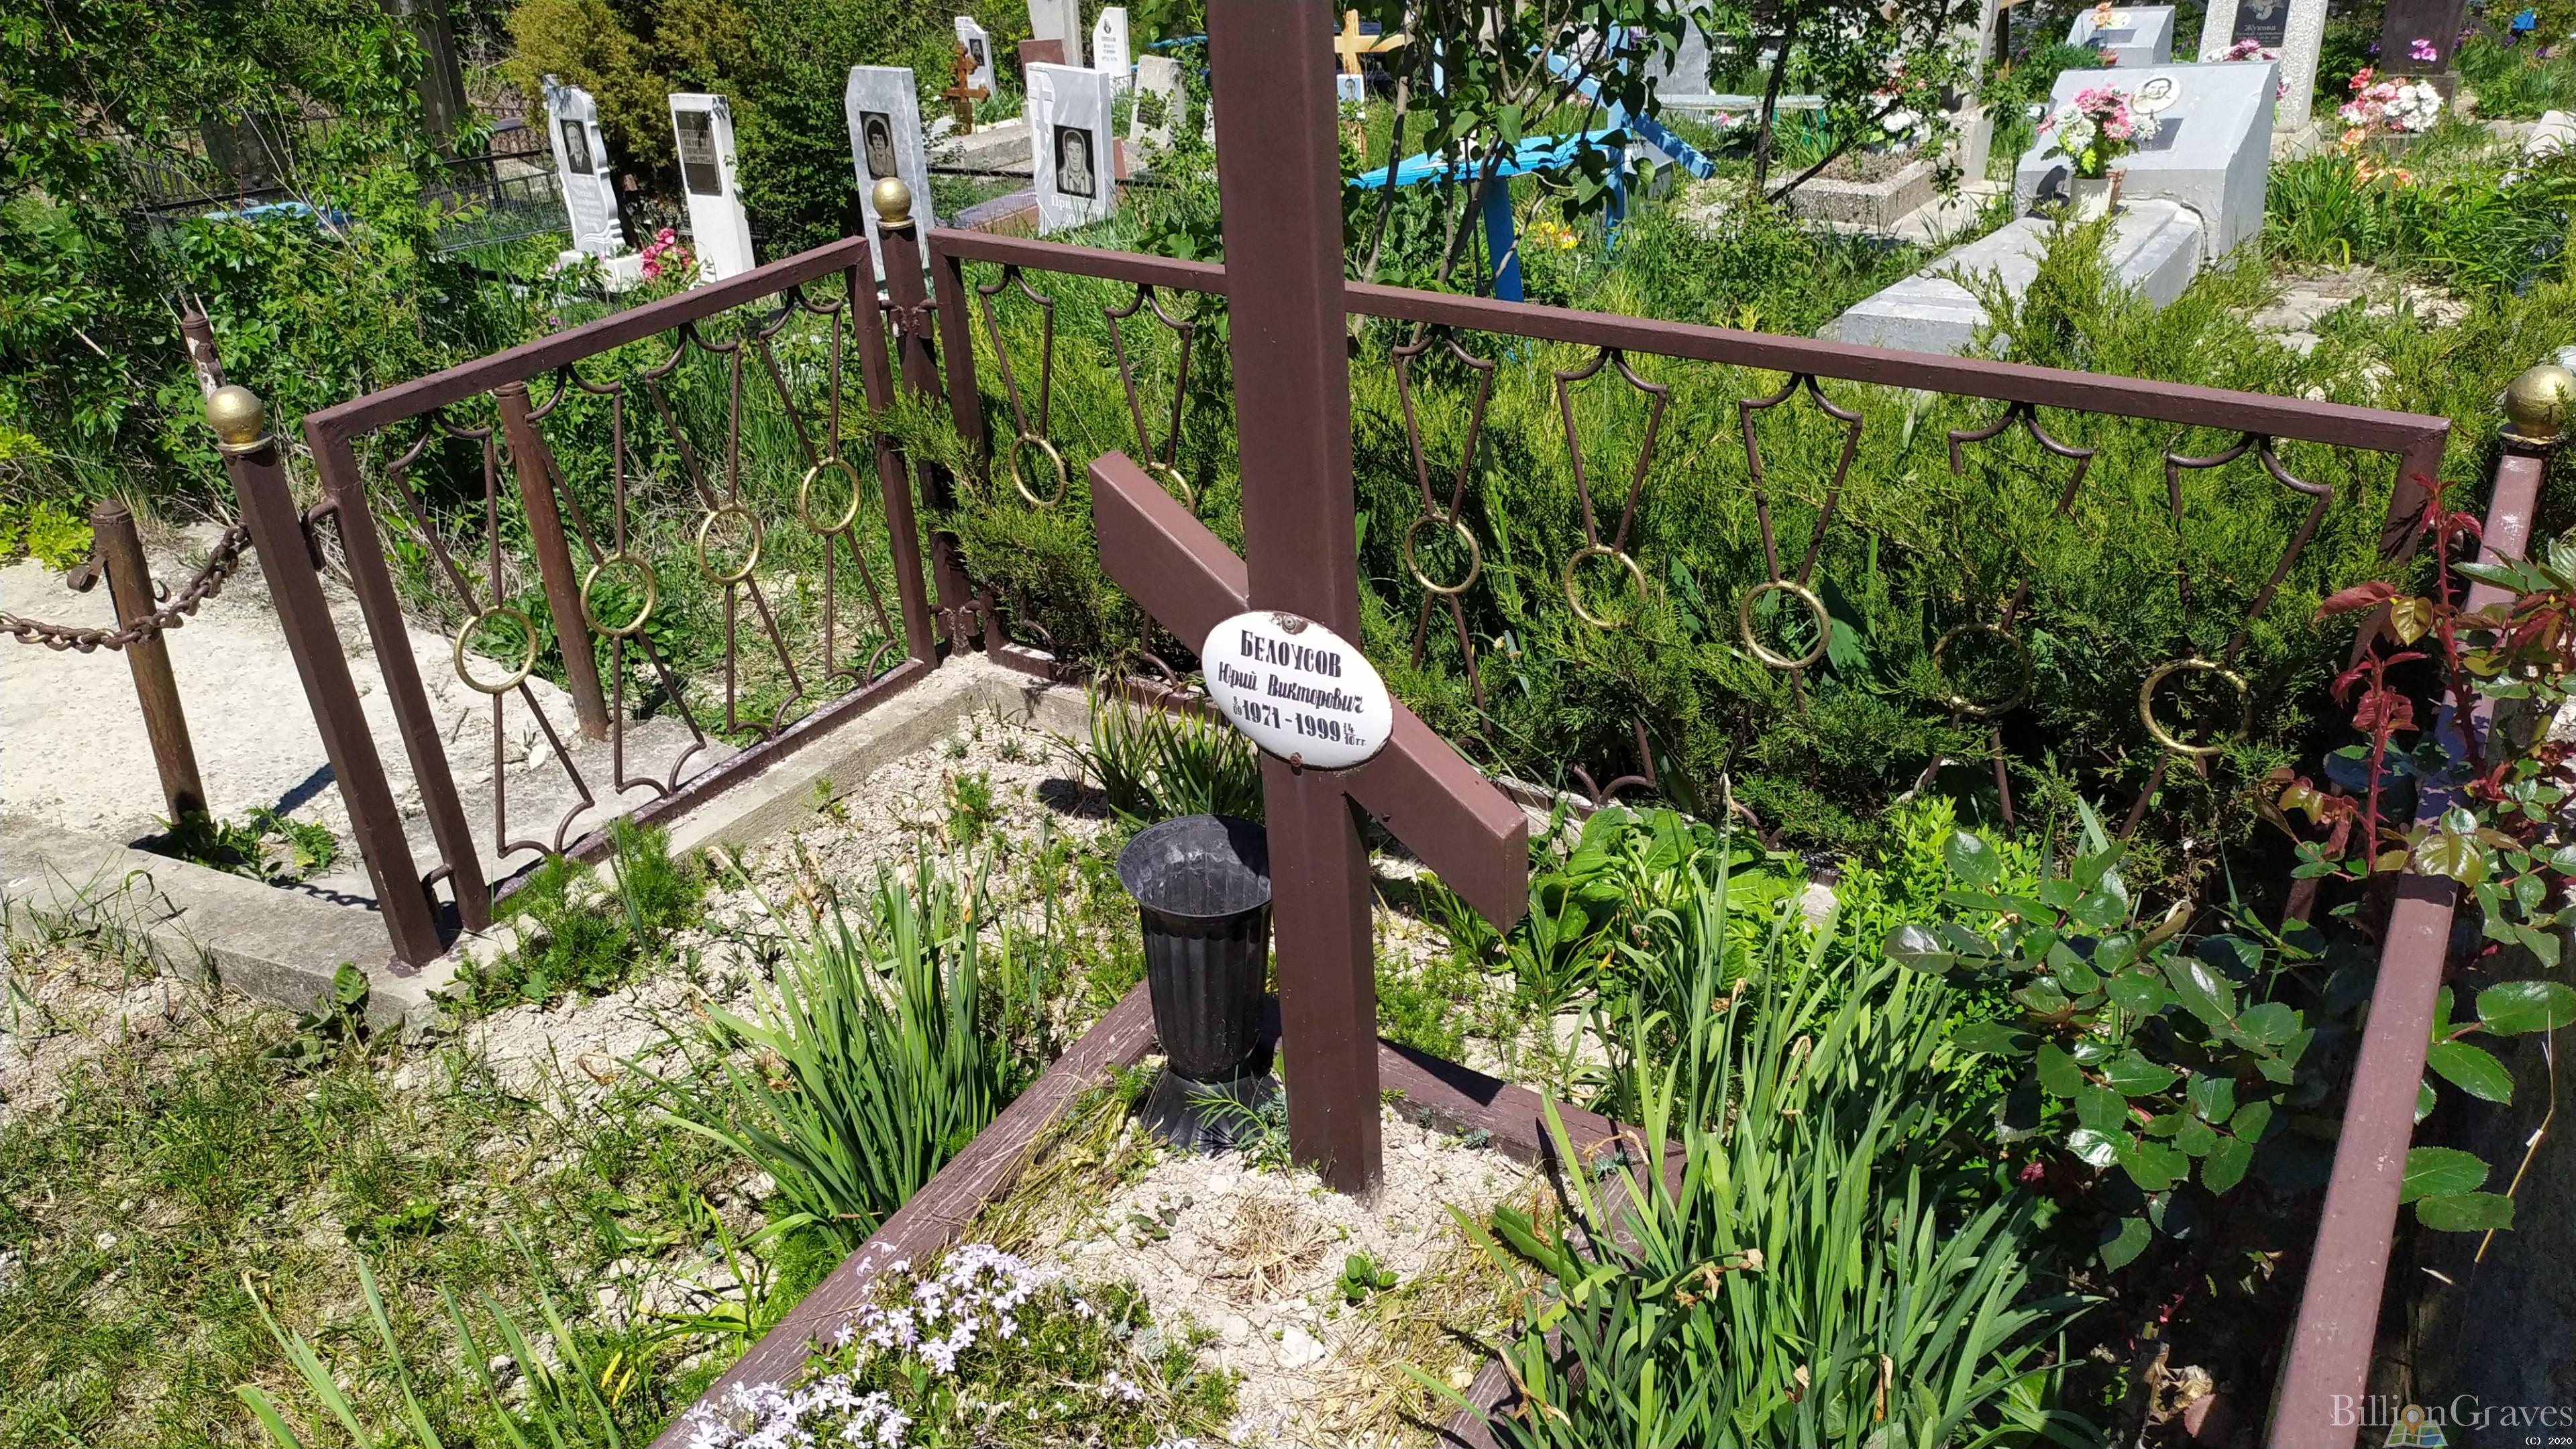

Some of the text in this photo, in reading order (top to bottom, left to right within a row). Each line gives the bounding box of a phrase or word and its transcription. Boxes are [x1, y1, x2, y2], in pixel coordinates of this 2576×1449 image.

[1241, 629, 1341, 678] БЕЛОУСОВ
[1218, 661, 1364, 713] Юрий Викторович
[1242, 700, 1281, 729] 1971
[1295, 713, 1340, 742] 1999
